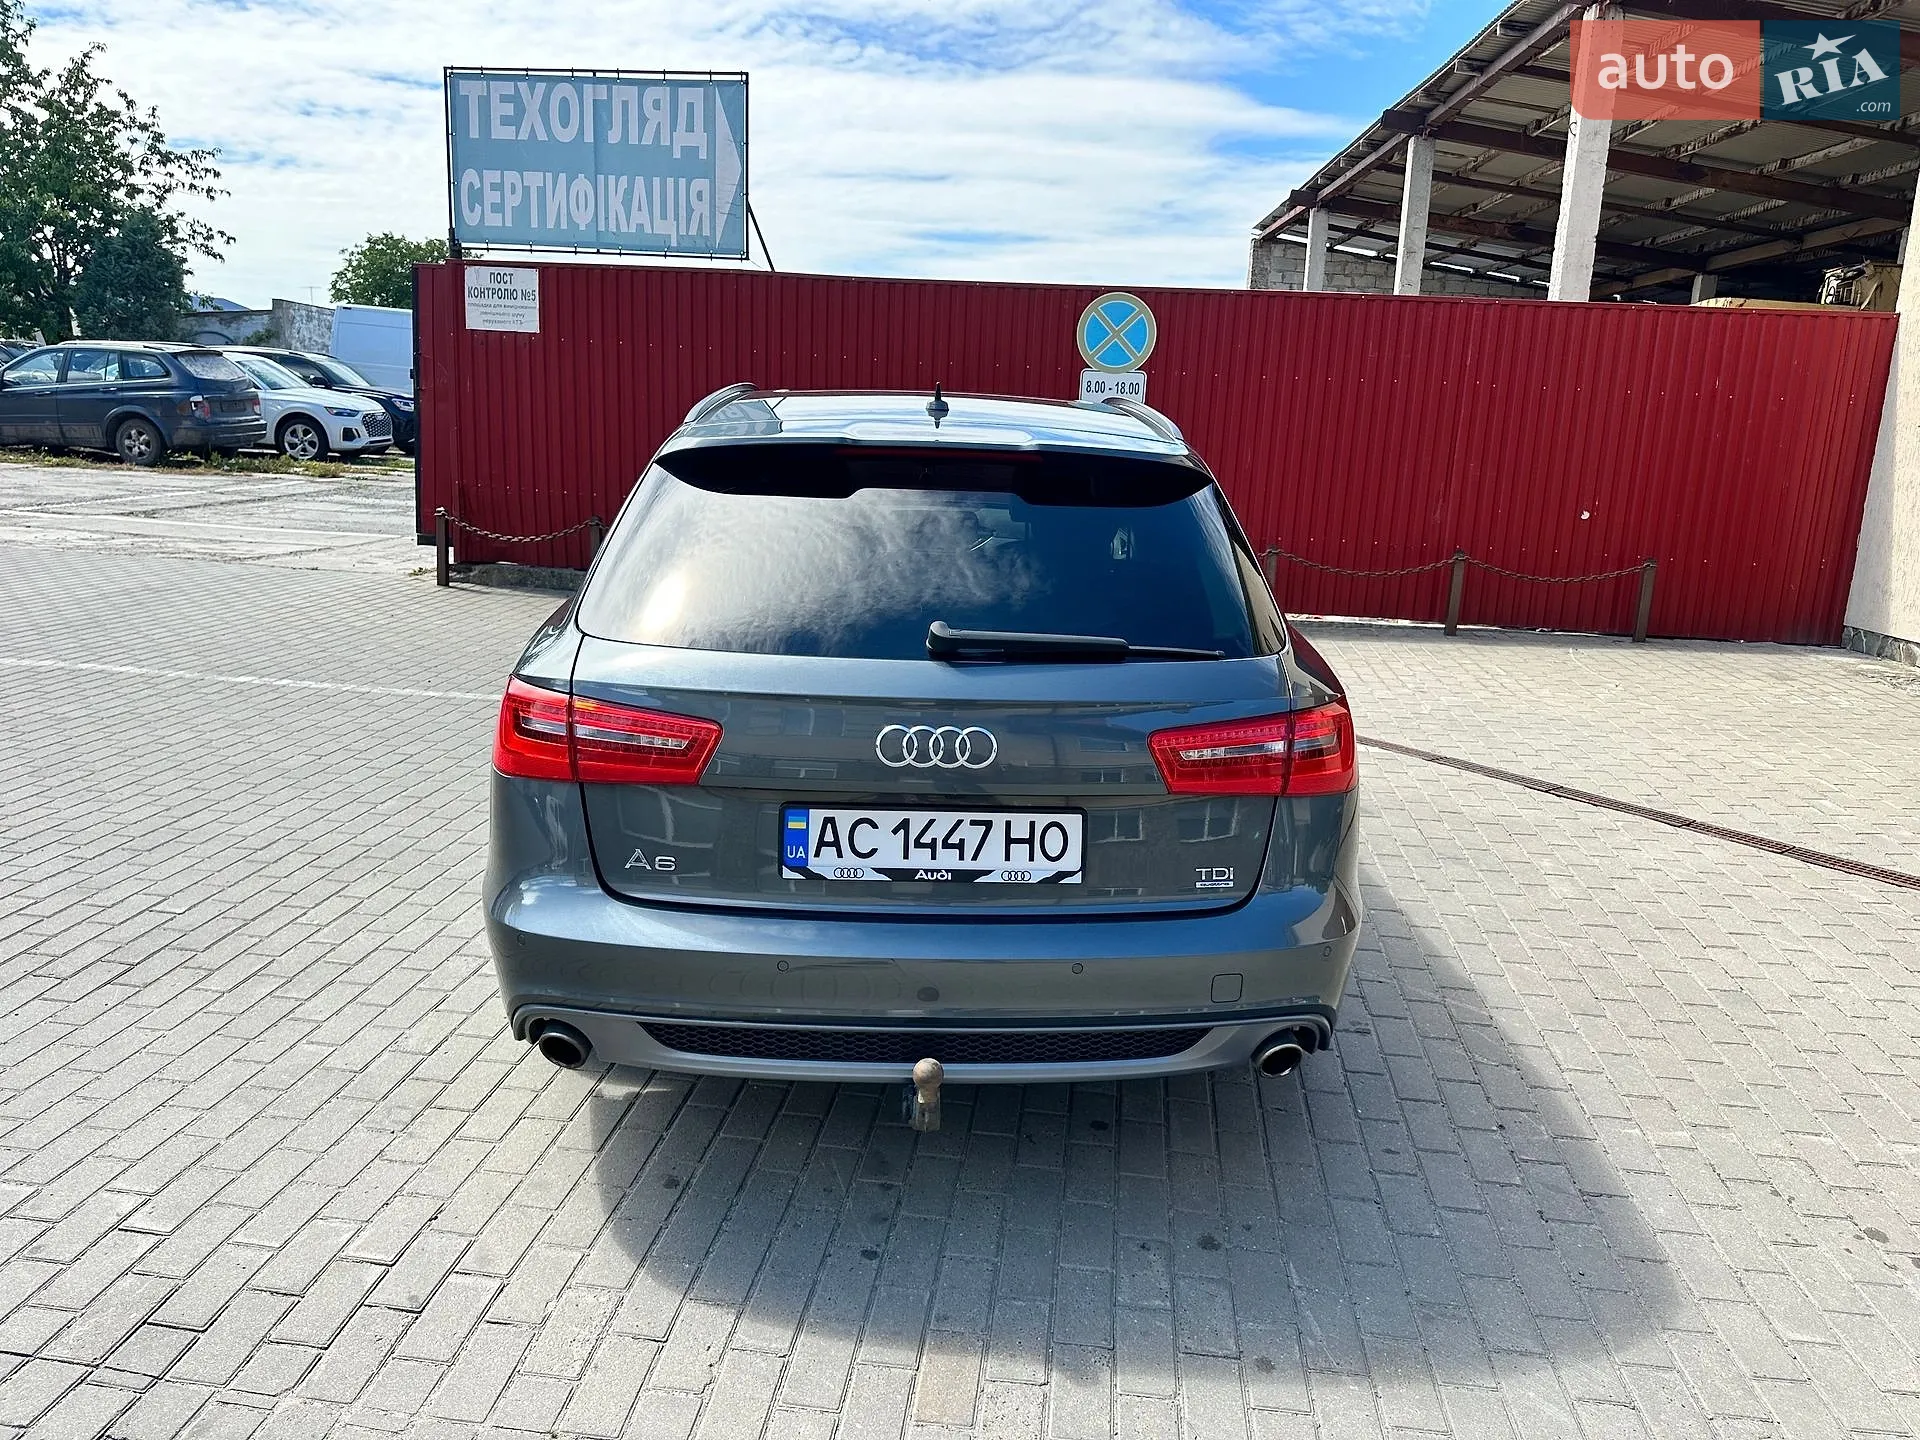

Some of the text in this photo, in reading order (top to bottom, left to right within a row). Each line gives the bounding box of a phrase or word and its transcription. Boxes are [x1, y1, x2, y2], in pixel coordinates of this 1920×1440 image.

[459, 80, 708, 160] ТЕХОГЛЯД
[460, 168, 711, 247] СЕРТИФІКАЦІЯ
[489, 272, 514, 285] ПОСТ
[467, 286, 537, 302] КОНТРОЛЮ №5
[1086, 381, 1106, 393] 8.00
[1115, 382, 1140, 395] 18.00
[813, 816, 1069, 863] AC 1447 HO
[624, 848, 676, 871] A6
[787, 846, 806, 859] UA
[914, 869, 952, 881] Audi
[1195, 867, 1234, 880] TDI
